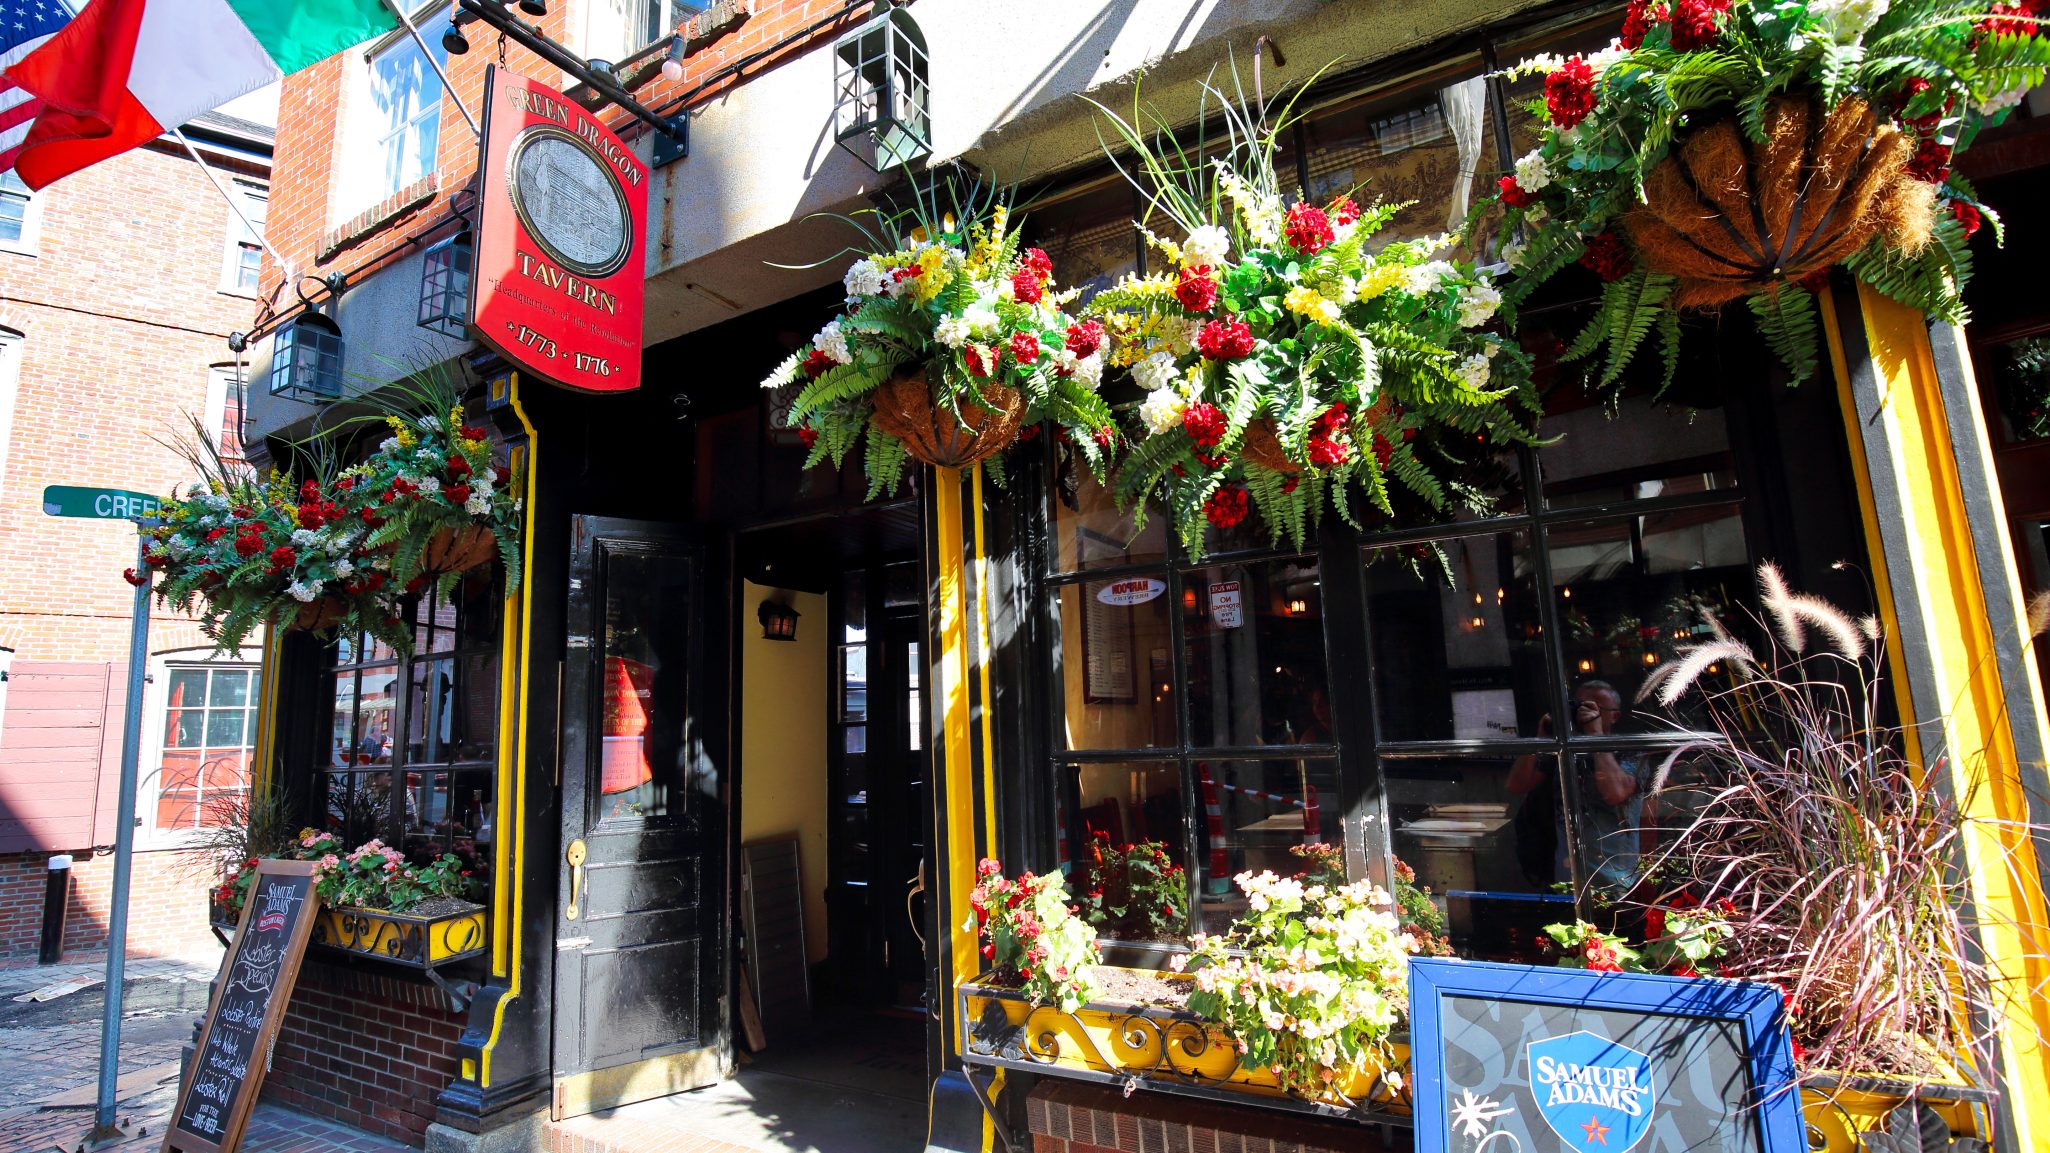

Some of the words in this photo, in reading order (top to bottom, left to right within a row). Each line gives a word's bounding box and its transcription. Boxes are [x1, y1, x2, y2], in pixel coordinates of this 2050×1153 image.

[505, 86, 569, 127] GREEN
[576, 113, 643, 187] DRAGON
[516, 250, 617, 316] TAVERN
[560, 310, 570, 322] of
[573, 313, 588, 330] the
[514, 323, 558, 360] 1773
[573, 350, 611, 377] 1776
[264, 898, 291, 915] ADAMS
[266, 882, 297, 901] SAMUEL
[1536, 1055, 1649, 1095] SAMUEL
[1546, 1080, 1642, 1117] ADAMS
